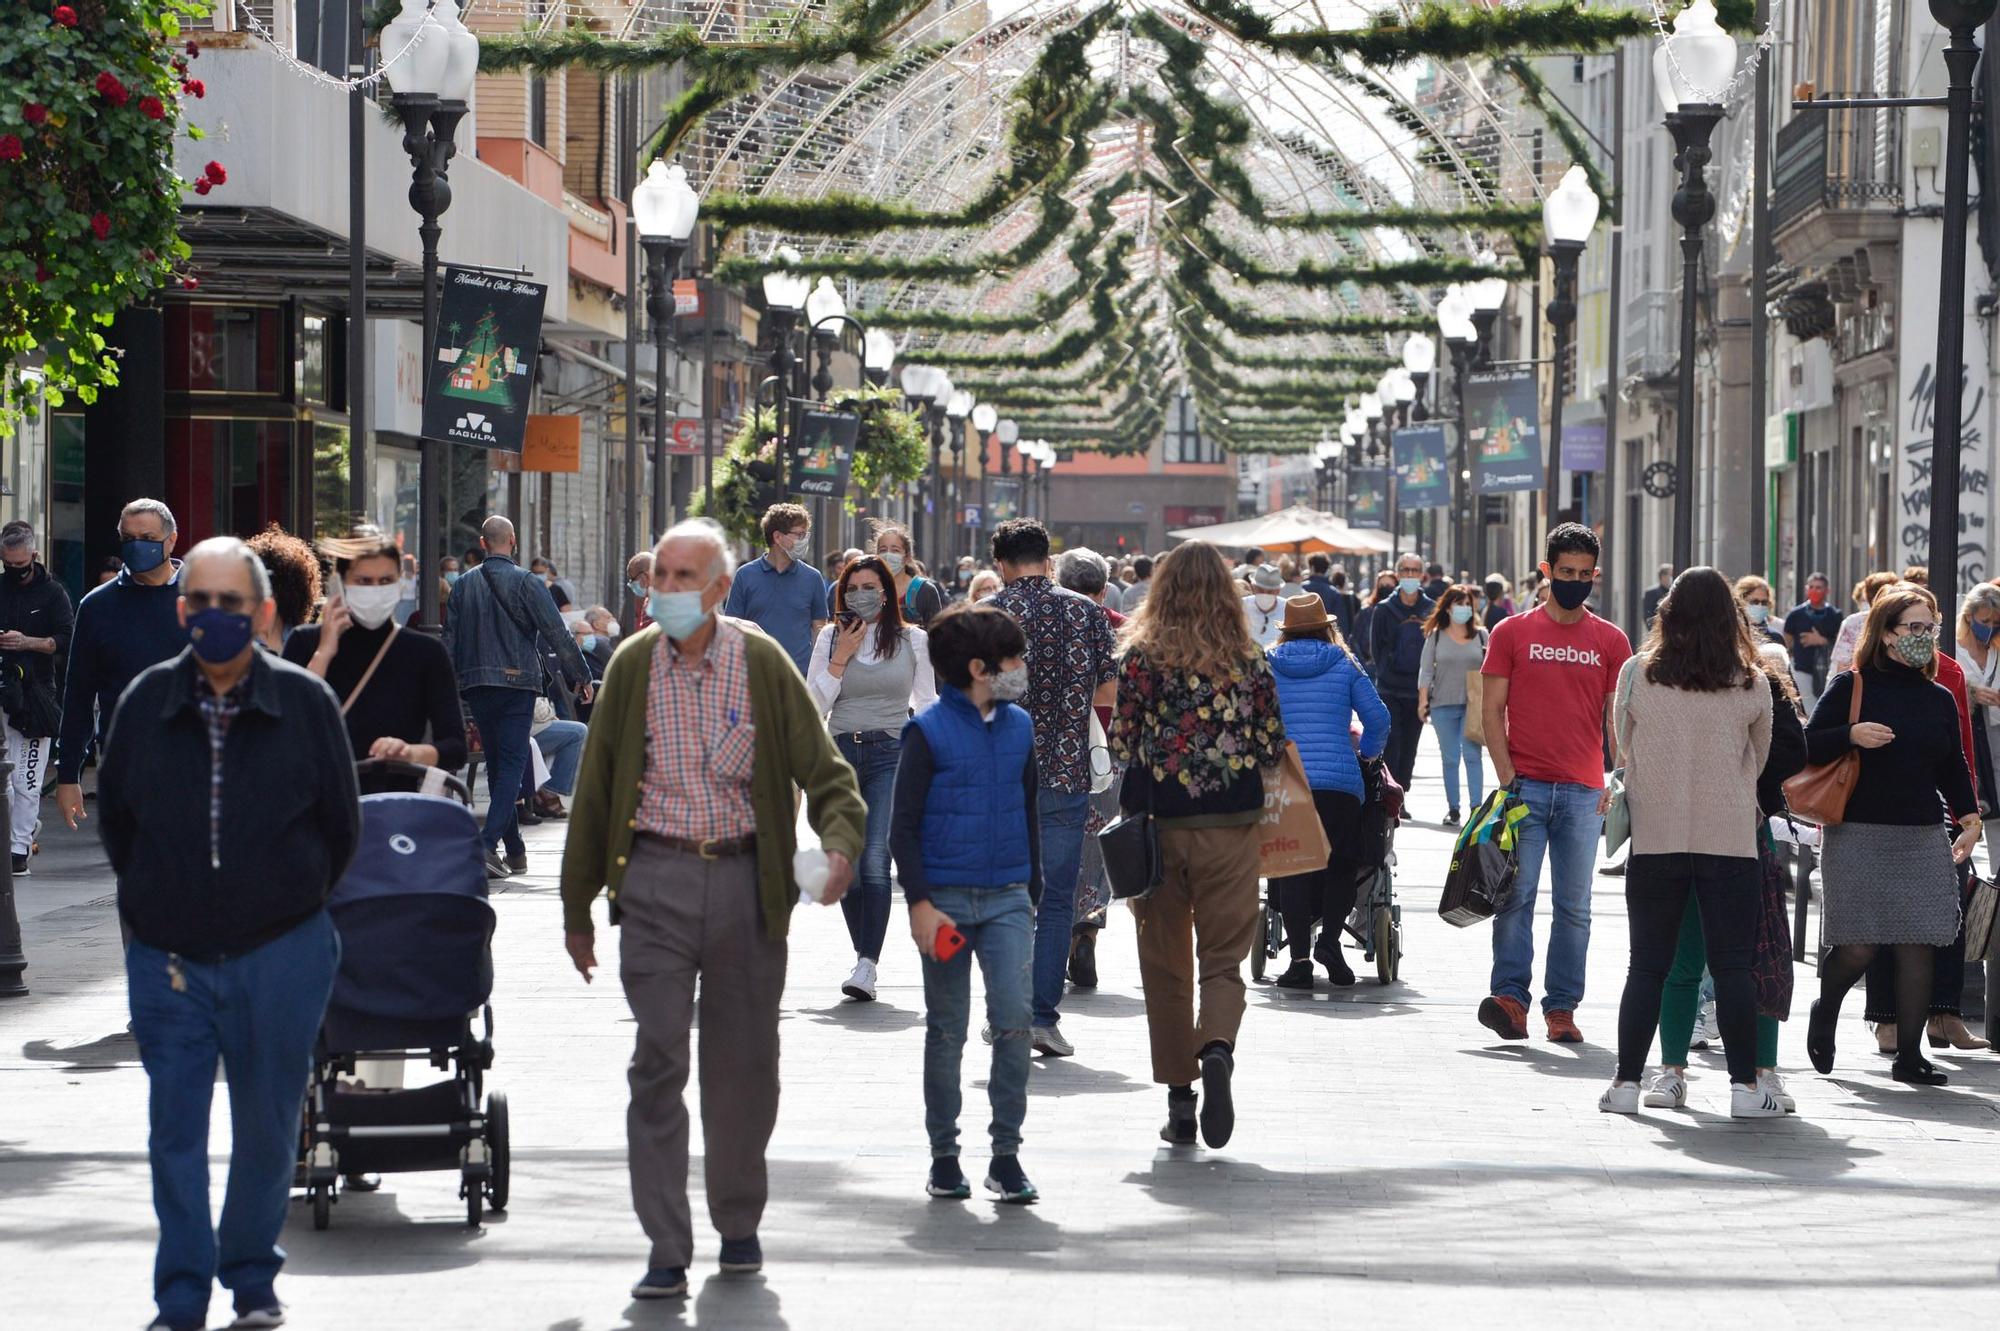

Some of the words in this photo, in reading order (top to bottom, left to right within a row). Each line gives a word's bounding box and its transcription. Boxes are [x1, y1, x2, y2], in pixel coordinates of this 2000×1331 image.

[455, 273, 488, 288] Navidad
[448, 428, 497, 442] SAGULPA
[1529, 643, 1602, 666] Reebok
[26, 738, 40, 791] eebok
[1263, 789, 1291, 813] 0%
